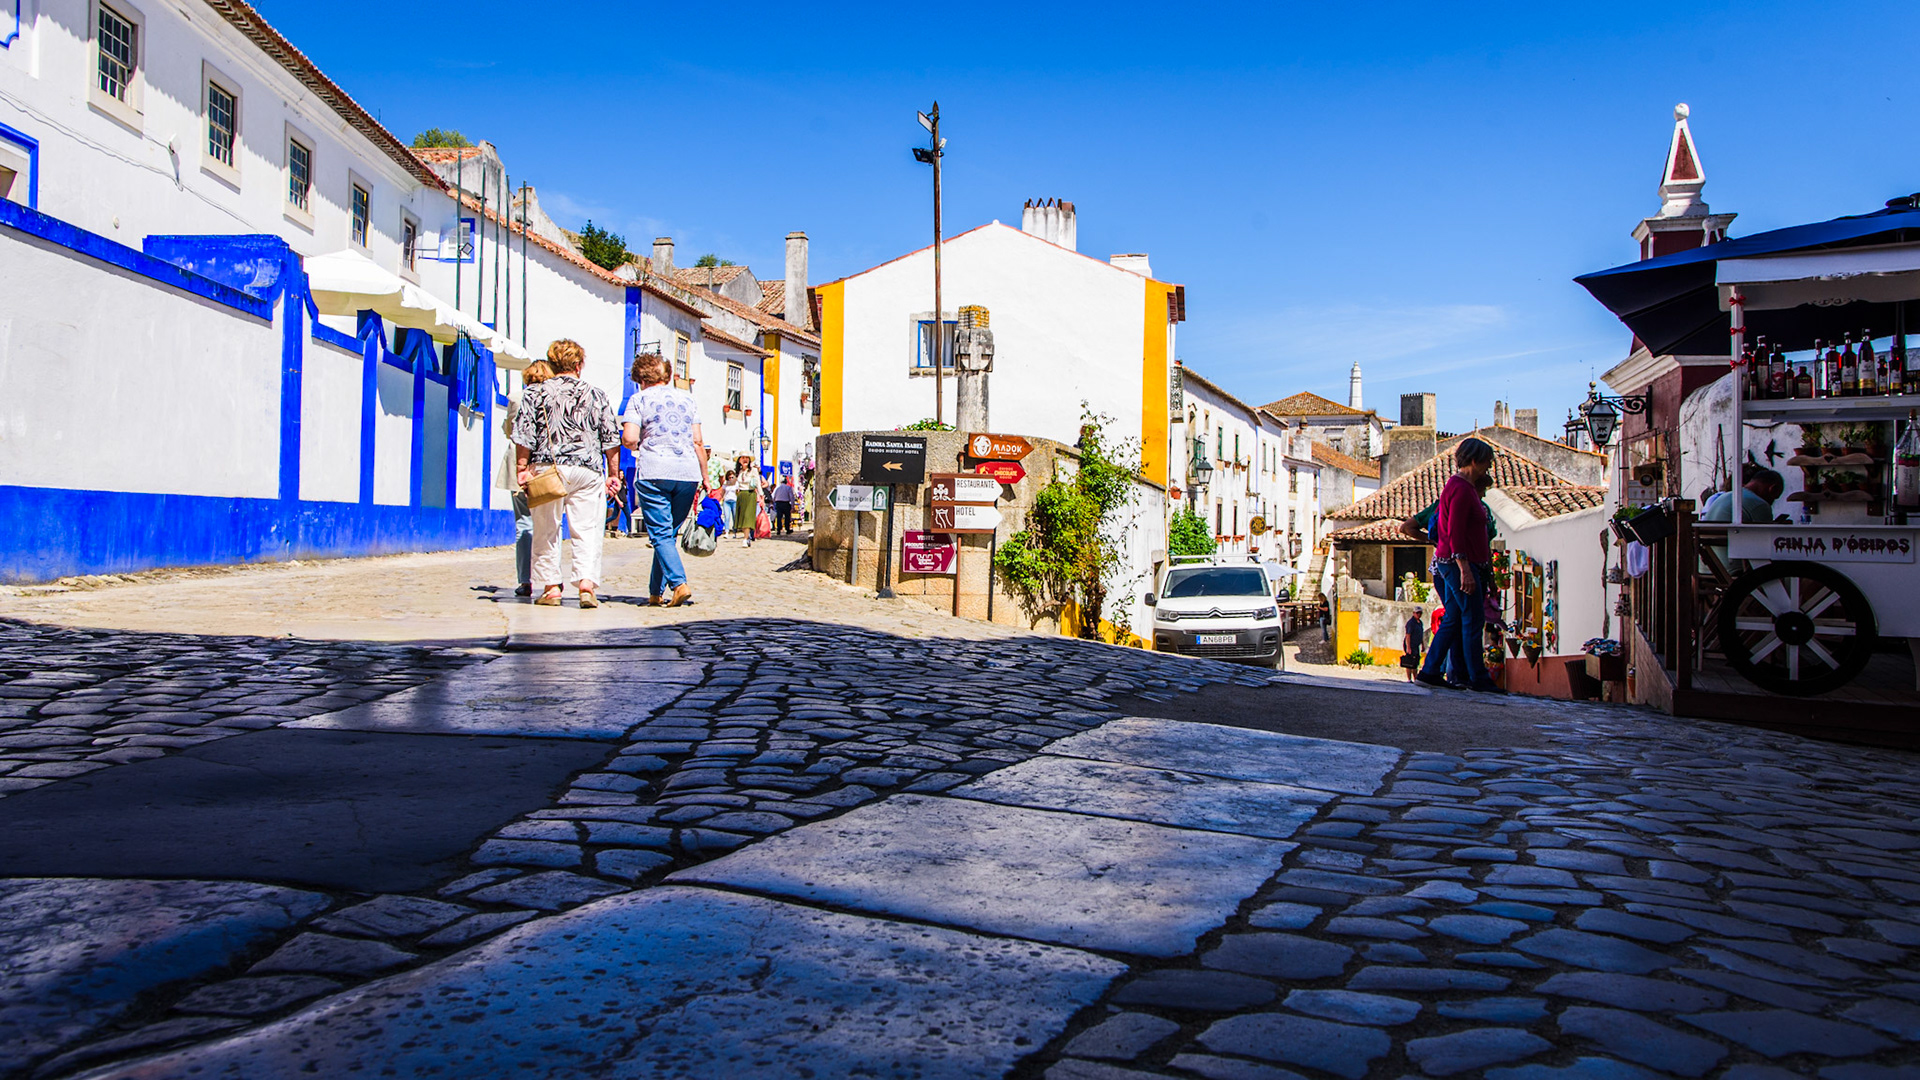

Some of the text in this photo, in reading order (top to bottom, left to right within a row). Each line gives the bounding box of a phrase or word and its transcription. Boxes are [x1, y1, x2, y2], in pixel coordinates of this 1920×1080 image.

[886, 441, 904, 449] SANTA
[904, 442, 923, 450] ISABEL
[956, 479, 995, 489] RESTAURANTE
[955, 506, 976, 516] HOTEL
[1773, 534, 1910, 556] GINJA D'ÓBIDOS
